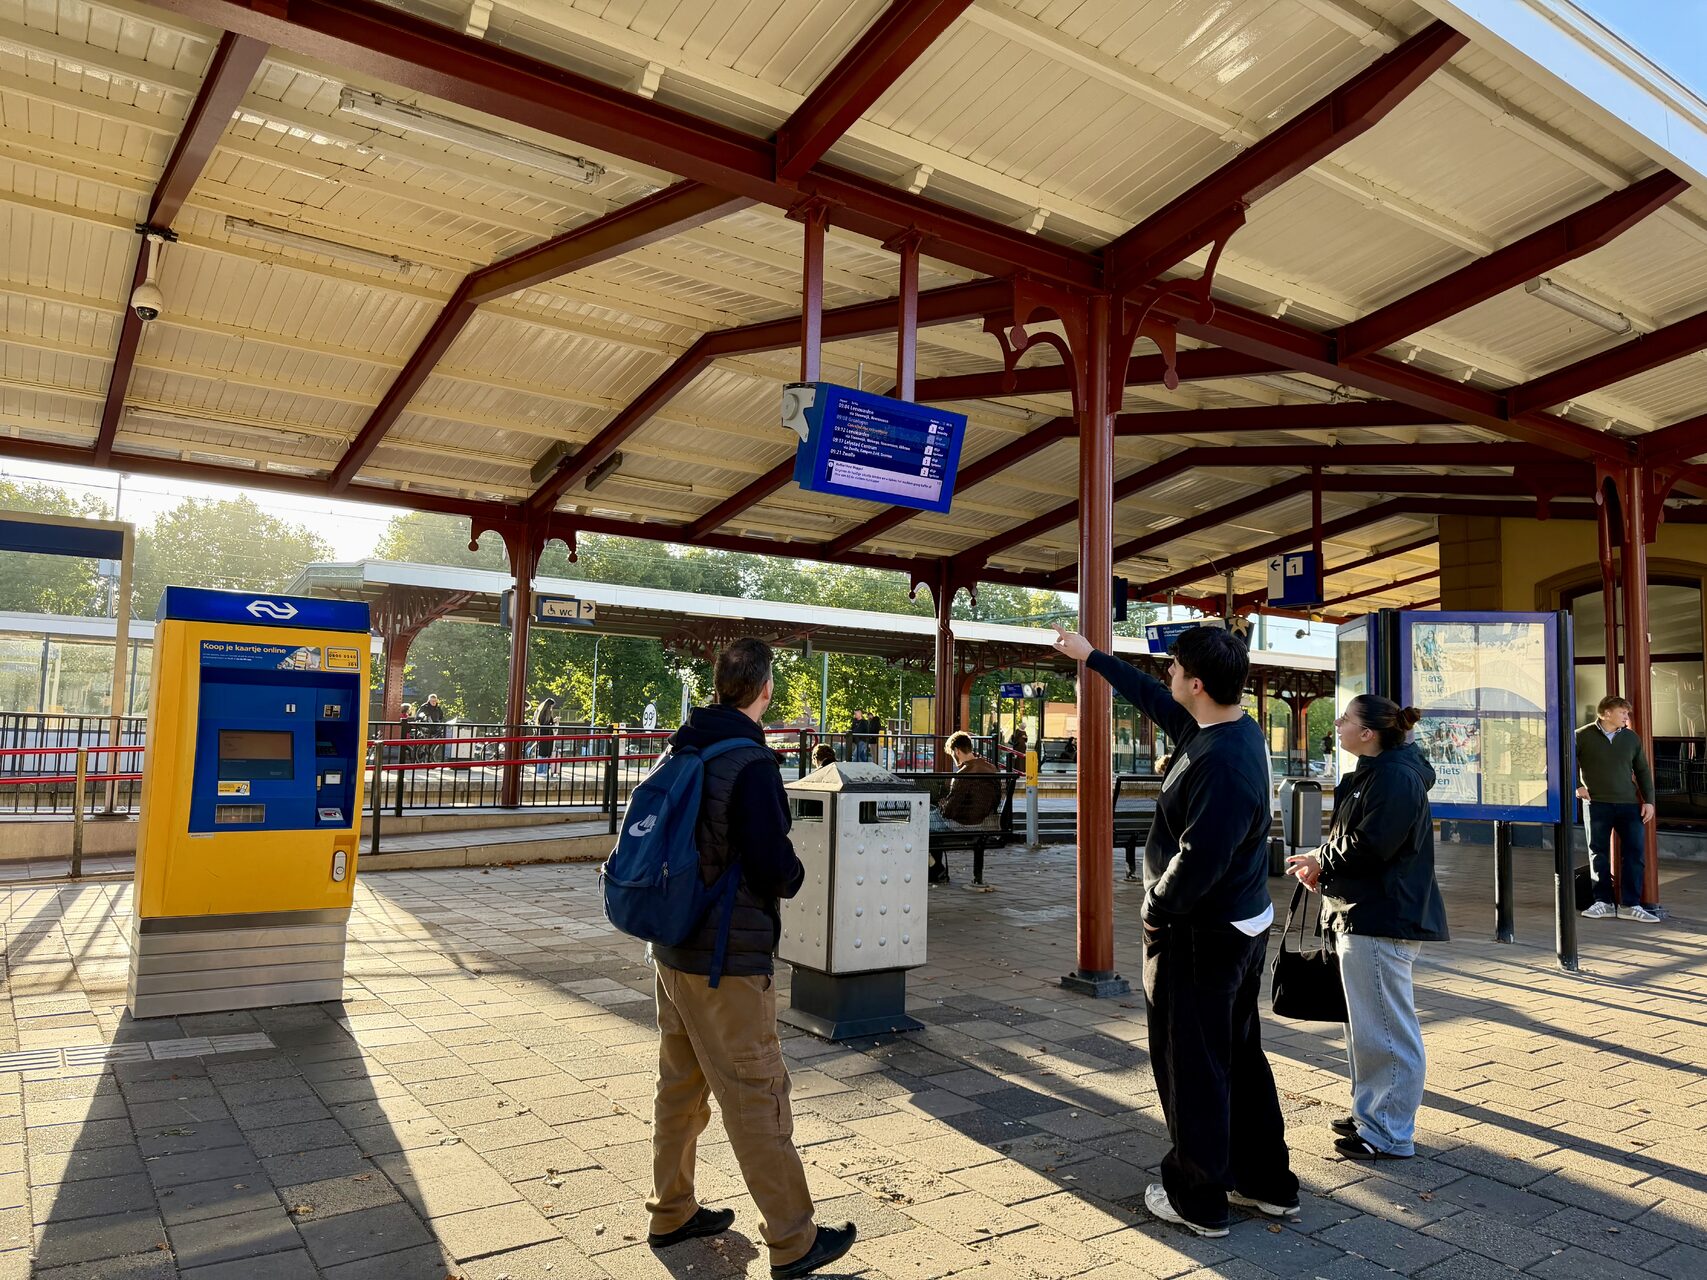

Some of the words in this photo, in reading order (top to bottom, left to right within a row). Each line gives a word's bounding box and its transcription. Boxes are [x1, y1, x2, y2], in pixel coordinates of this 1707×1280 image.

[1292, 564, 1296, 574] 1
[203, 643, 224, 651] Koop
[235, 645, 261, 653] kaartje
[1420, 674, 1442, 682] Fiets
[1434, 765, 1460, 775] -fiets
